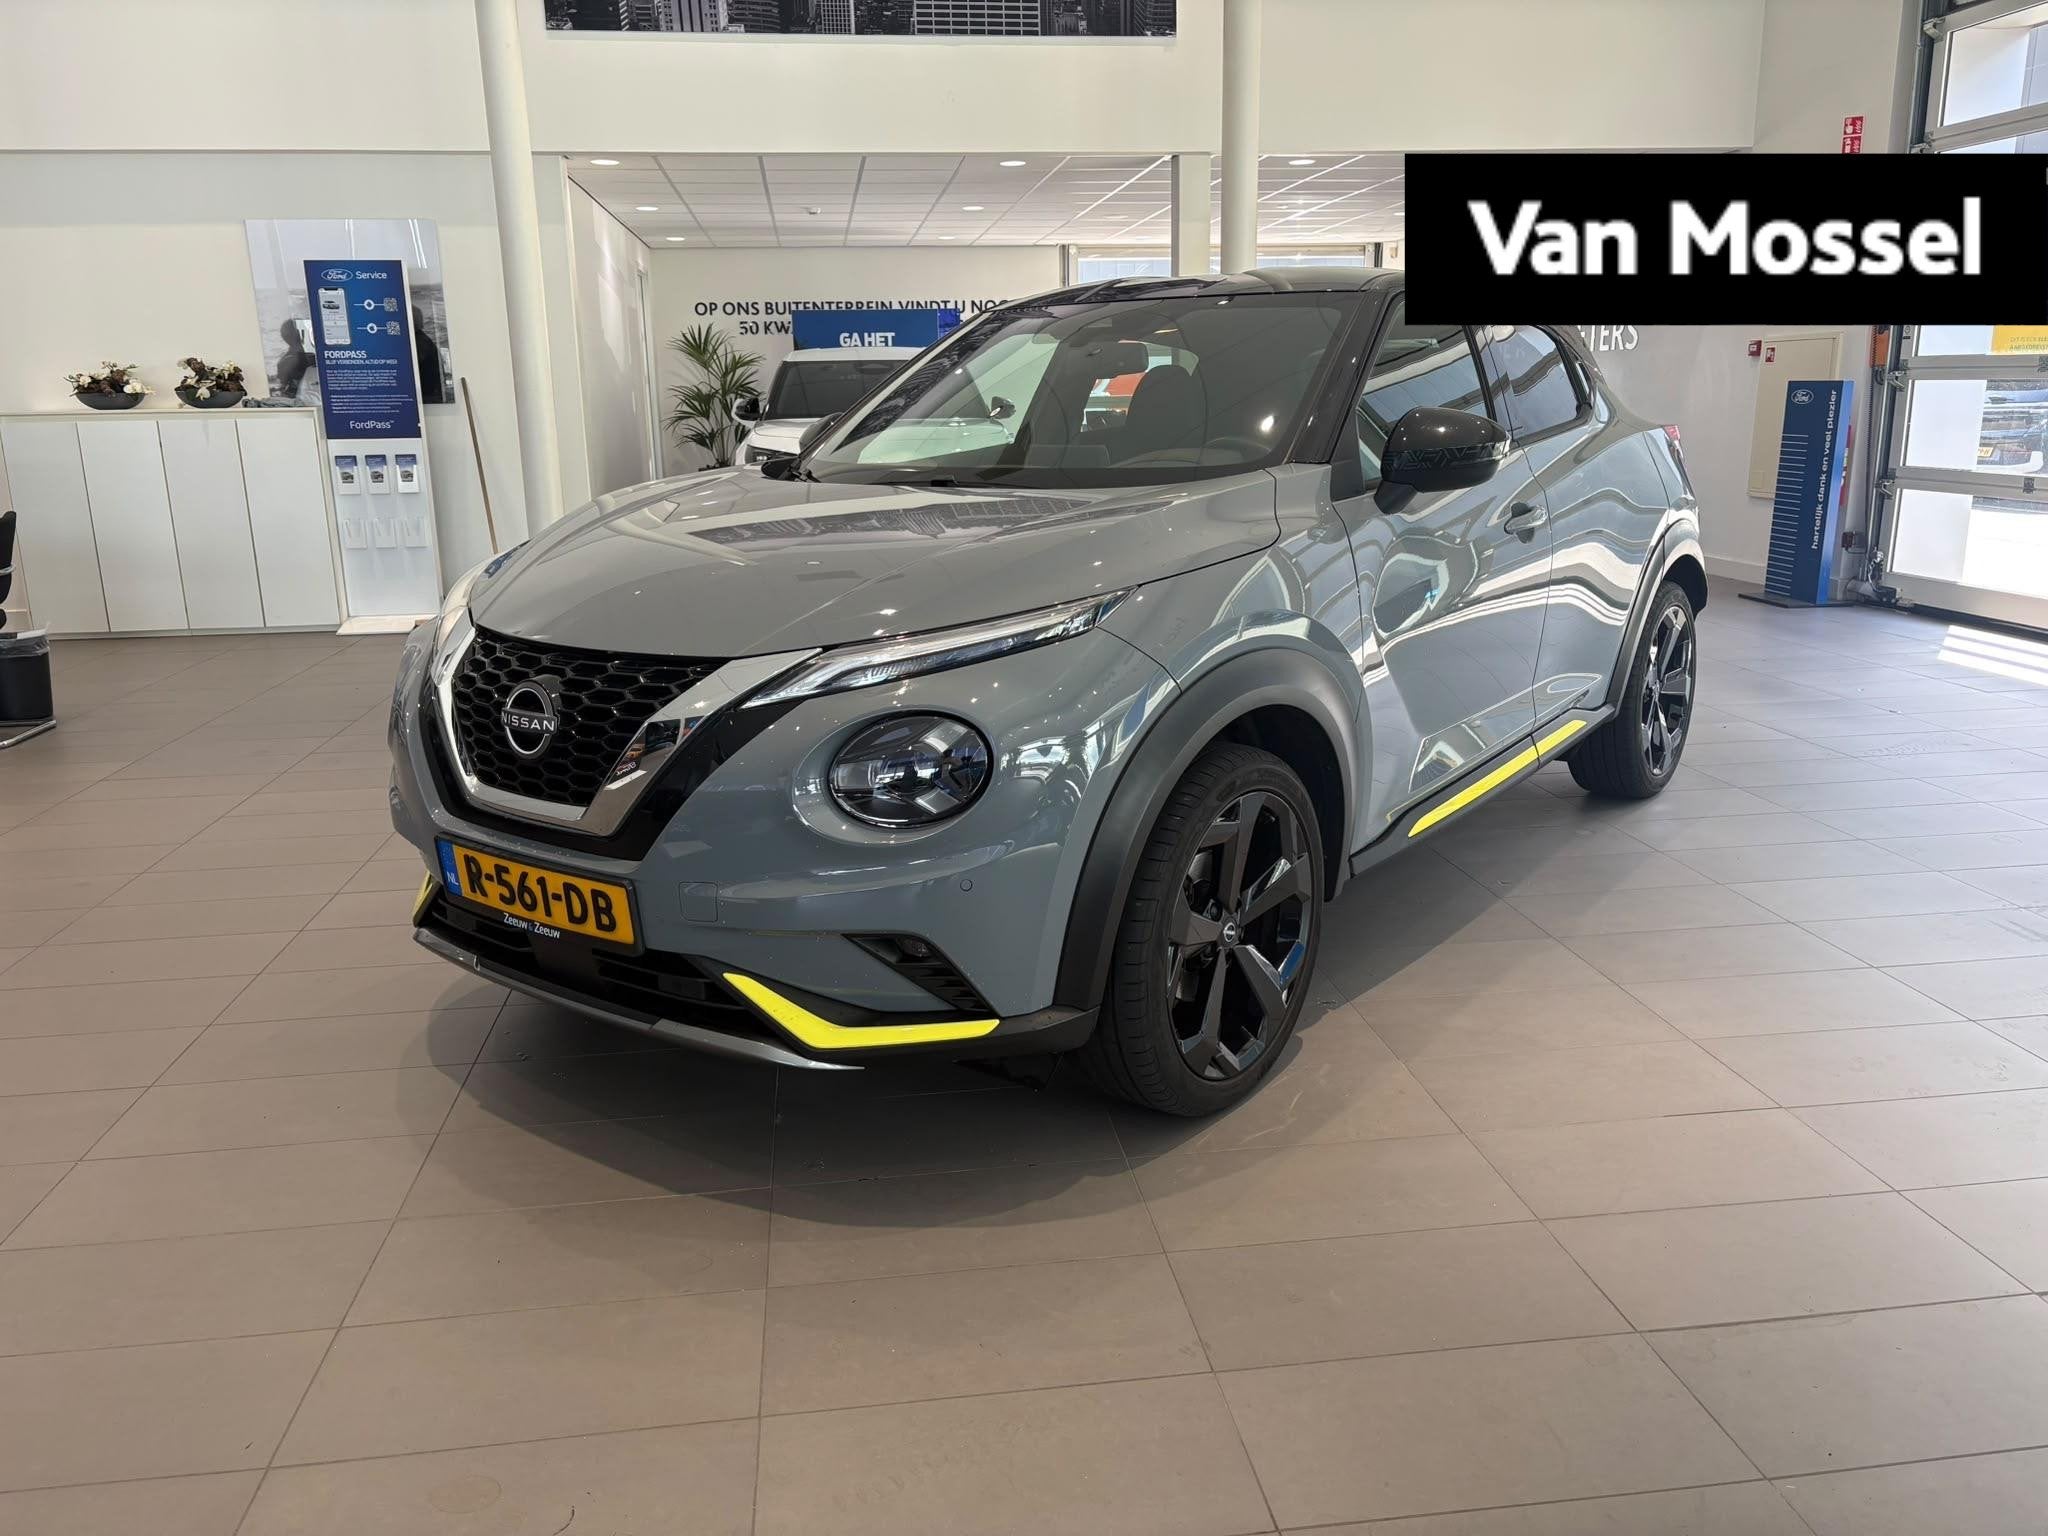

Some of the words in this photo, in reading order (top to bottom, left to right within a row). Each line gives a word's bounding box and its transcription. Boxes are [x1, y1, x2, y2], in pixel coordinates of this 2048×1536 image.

[327, 269, 348, 279] Ford
[355, 270, 388, 279] Service
[694, 302, 718, 316] OP
[722, 302, 760, 316] ONS
[739, 320, 760, 335] 50
[839, 332, 861, 347] GA
[864, 332, 895, 347] HET
[324, 350, 367, 359] FORDPASS
[1827, 389, 1837, 429] plezier
[1824, 430, 1832, 455] veel
[1822, 457, 1829, 472] en
[1818, 473, 1827, 502] dank
[1811, 503, 1824, 550] hartelijk
[501, 711, 555, 732] NISSAN
[447, 872, 459, 886] NL
[464, 853, 617, 933] R-561-DB
[503, 912, 528, 930] Zeeuw
[534, 921, 560, 939] Zeeuw
